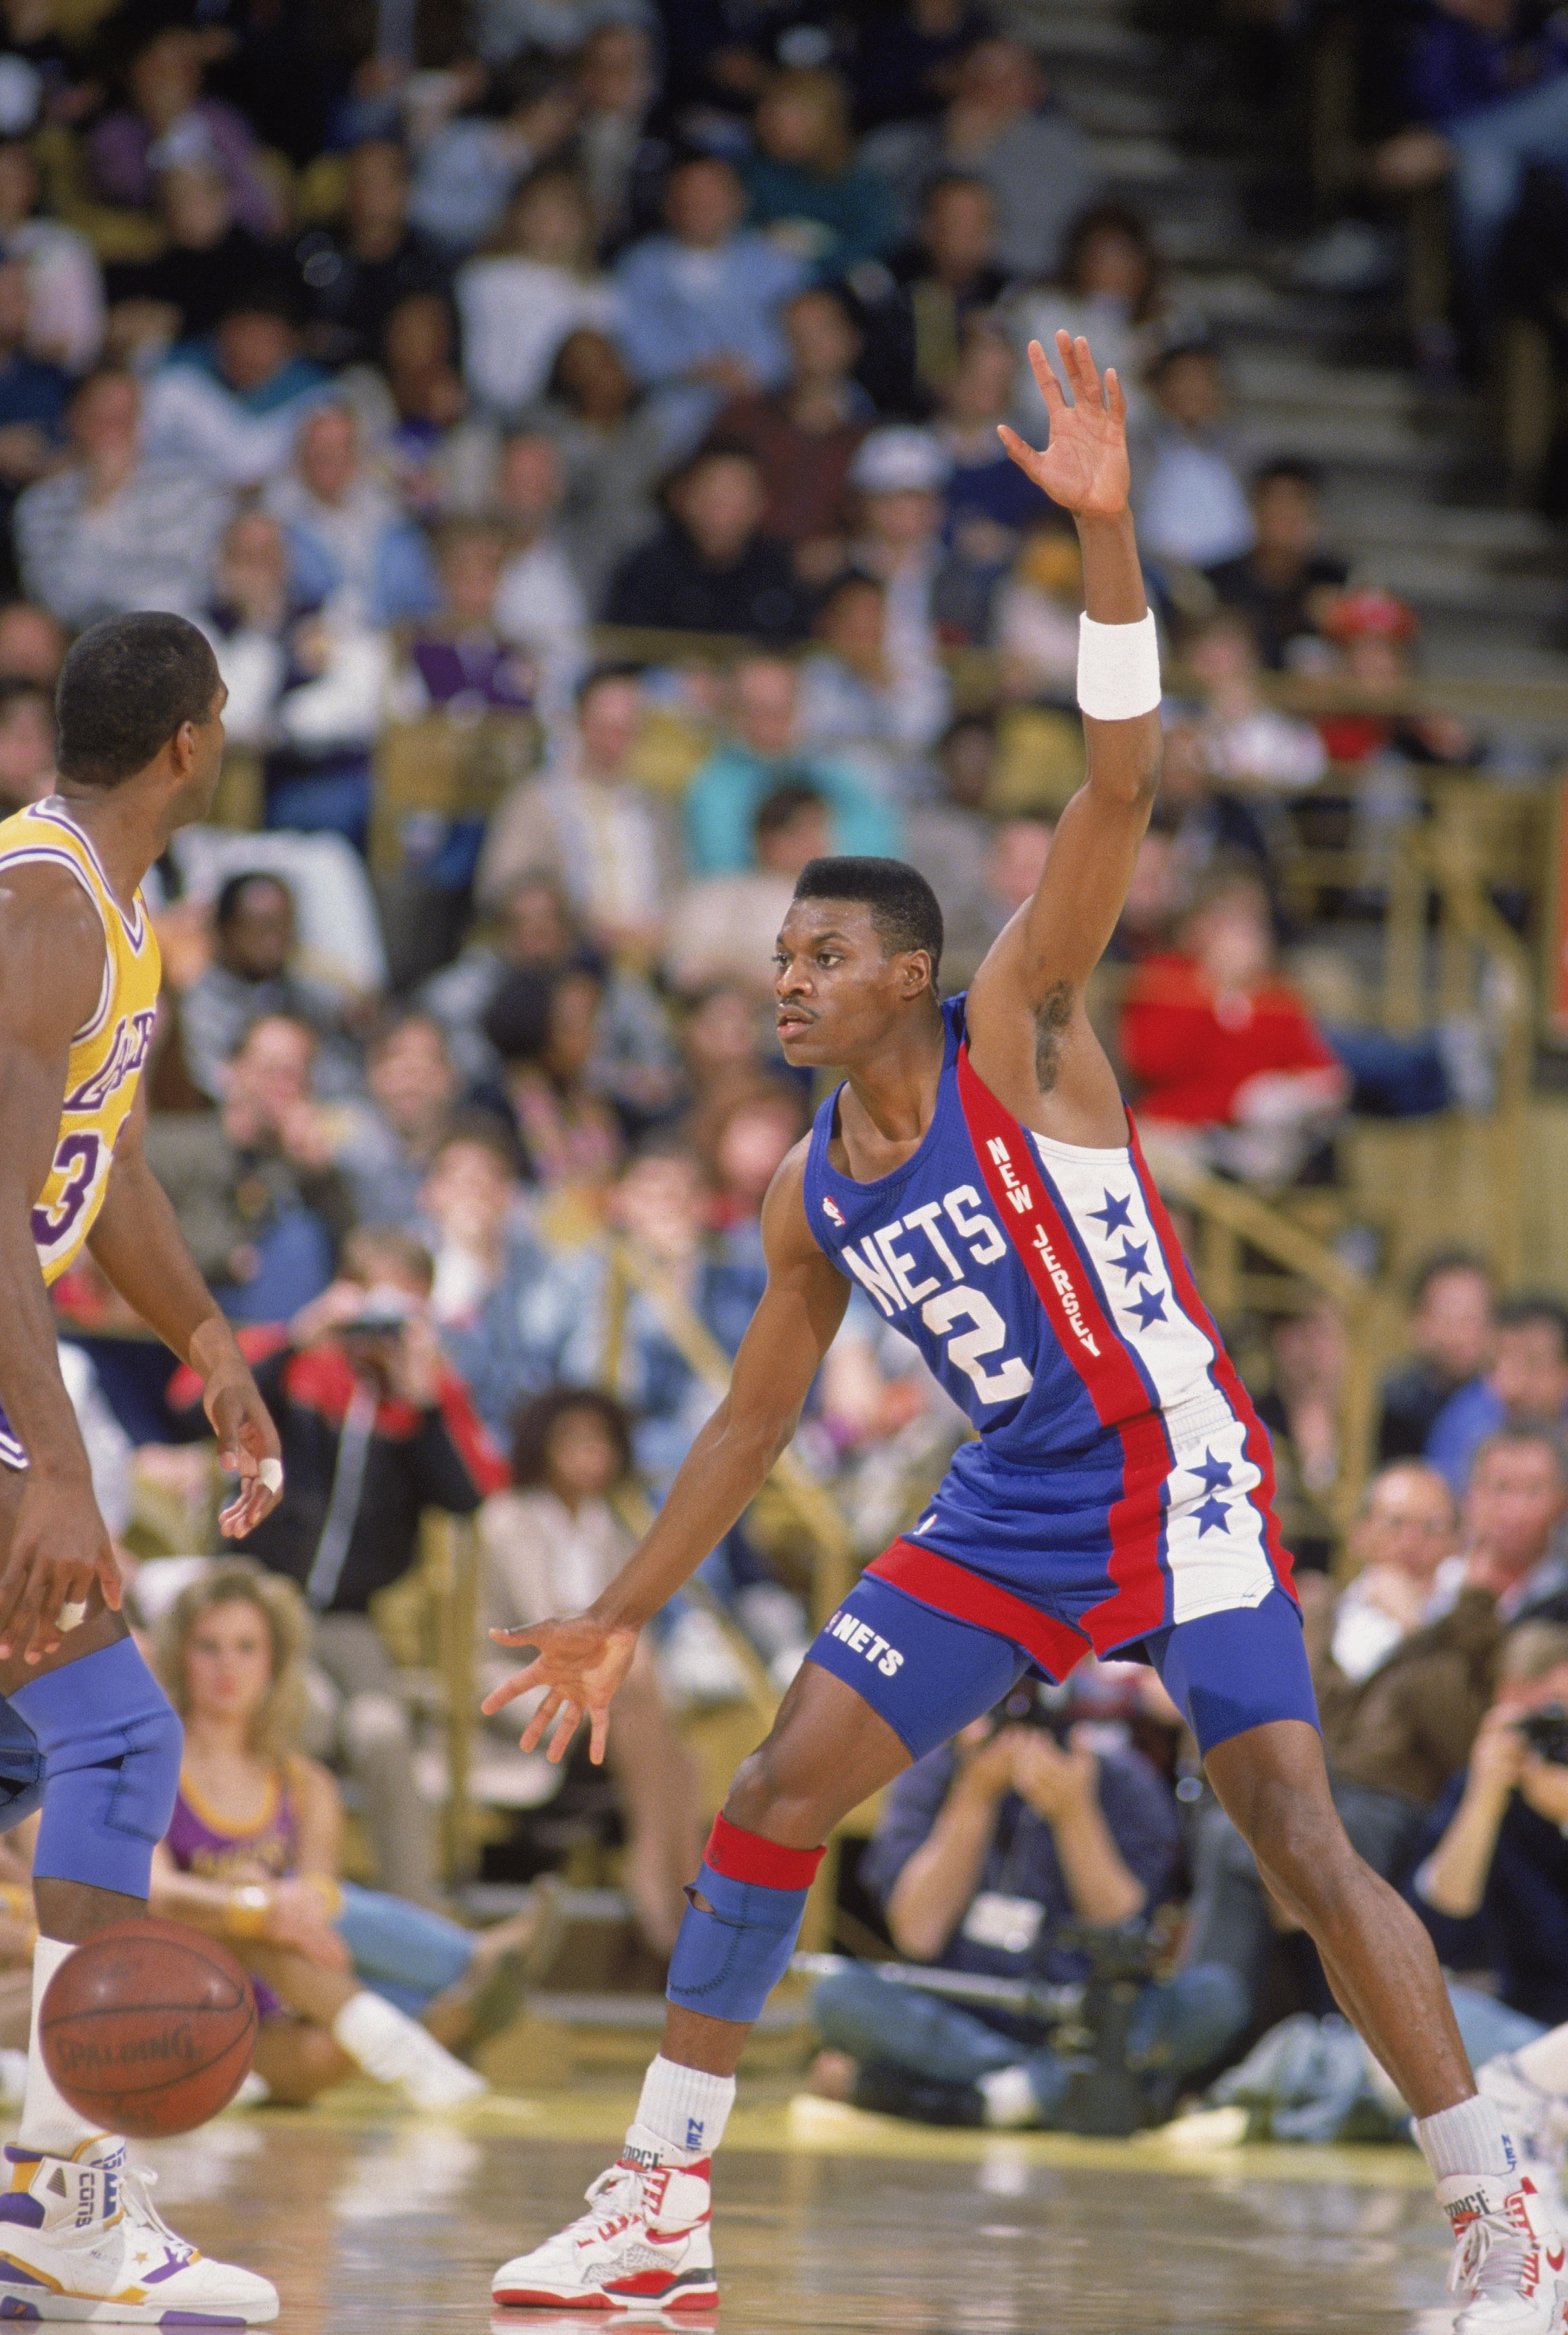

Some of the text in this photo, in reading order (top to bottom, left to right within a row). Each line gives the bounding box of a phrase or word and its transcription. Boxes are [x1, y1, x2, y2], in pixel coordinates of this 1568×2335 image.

[30, 1115, 129, 1264] 3
[841, 1184, 1007, 1317] NETS
[986, 1137, 1101, 1357] NEW JERSEY
[922, 1285, 1034, 1405] 2
[832, 1613, 904, 1677] NETS
